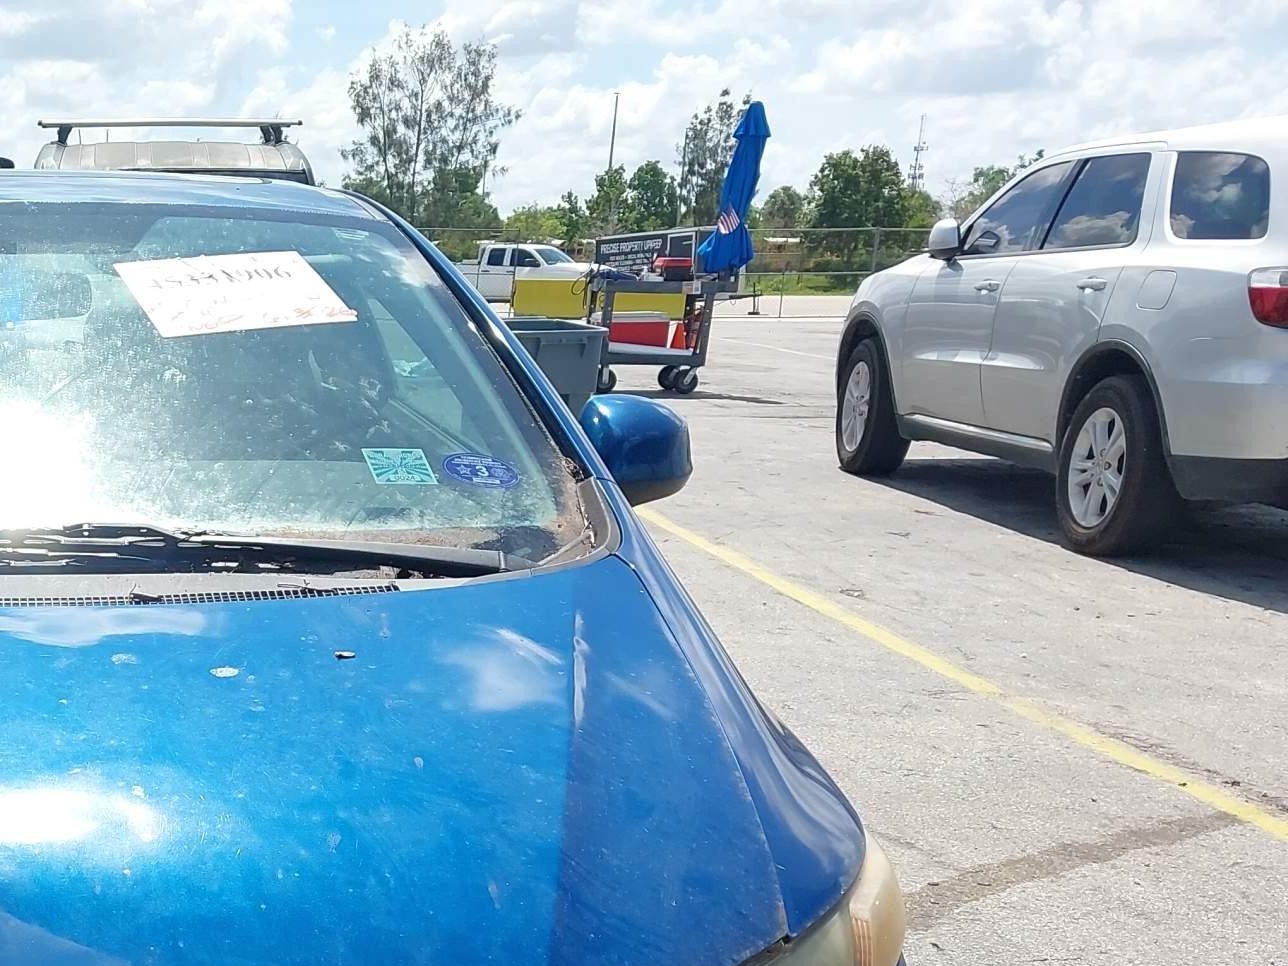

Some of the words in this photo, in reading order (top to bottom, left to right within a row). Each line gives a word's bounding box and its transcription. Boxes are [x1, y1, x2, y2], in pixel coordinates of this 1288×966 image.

[601, 243, 620, 254] PRECISE
[620, 241, 643, 252] PROPERTY
[475, 465, 489, 477] 3
